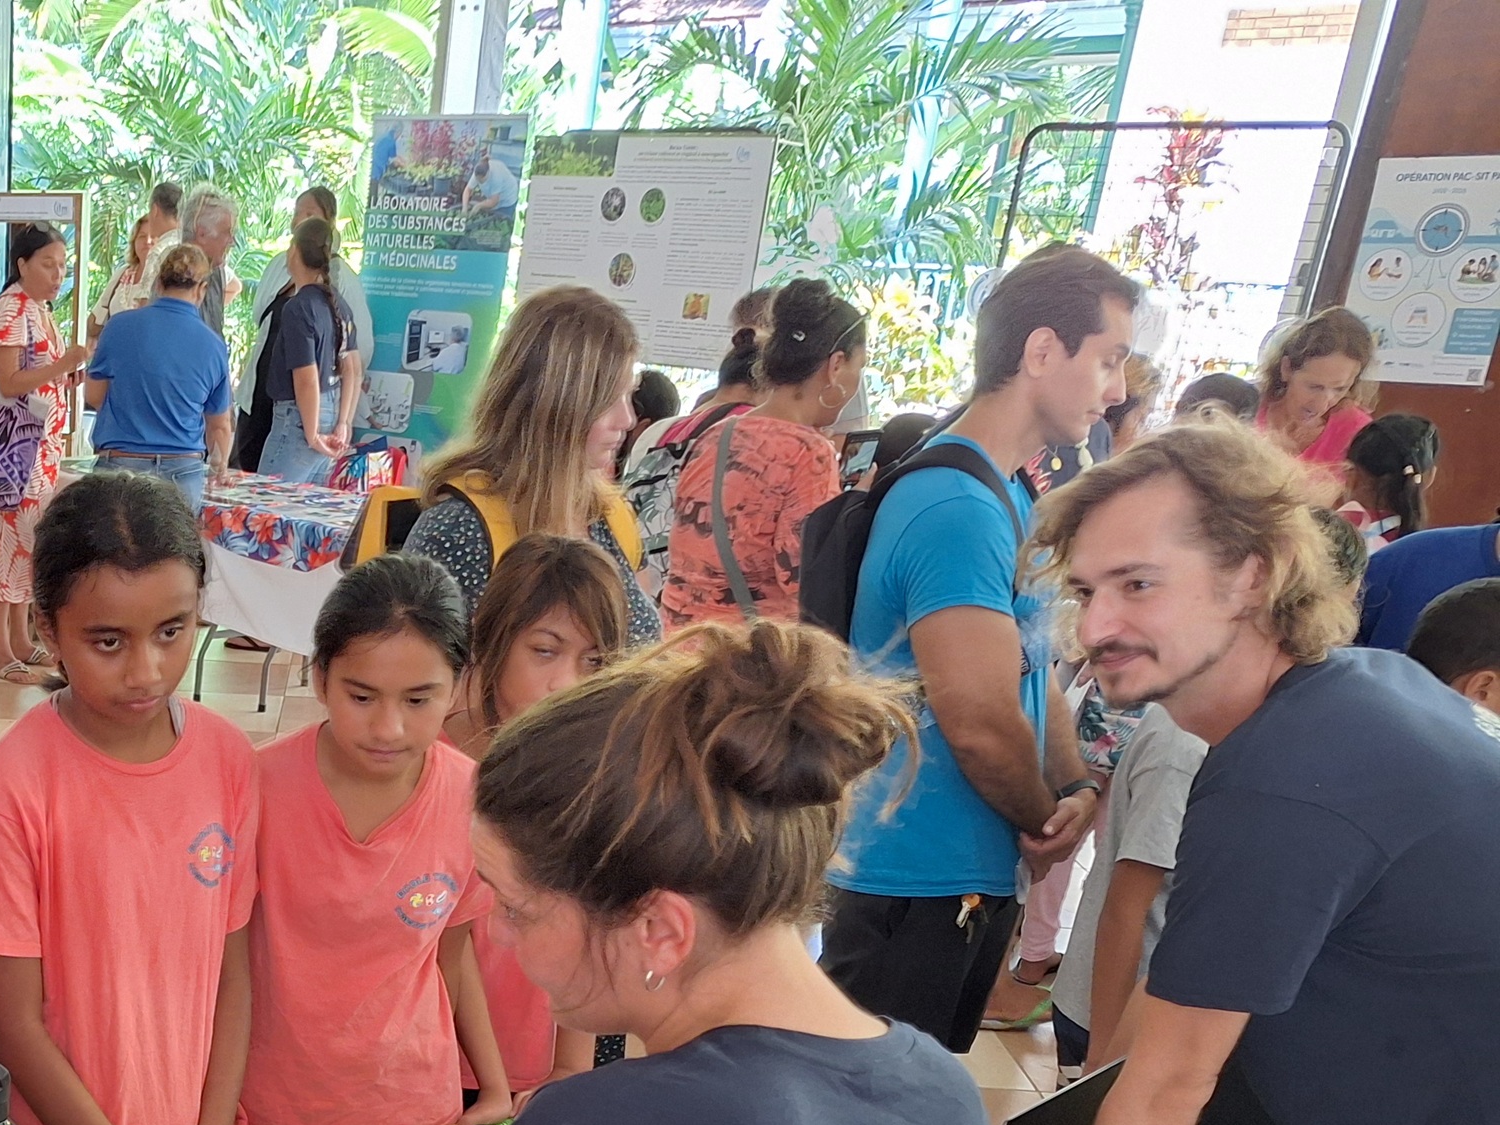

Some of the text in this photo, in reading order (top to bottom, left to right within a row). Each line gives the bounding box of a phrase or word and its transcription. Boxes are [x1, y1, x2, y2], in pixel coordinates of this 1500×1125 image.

[1396, 172, 1451, 182] OPÉRATION
[370, 196, 448, 211] LABORATOIRE
[368, 214, 466, 232] DES SUBSTANCES
[365, 233, 435, 250] NATURELLES
[363, 250, 458, 270] ET MÉDICINALES
